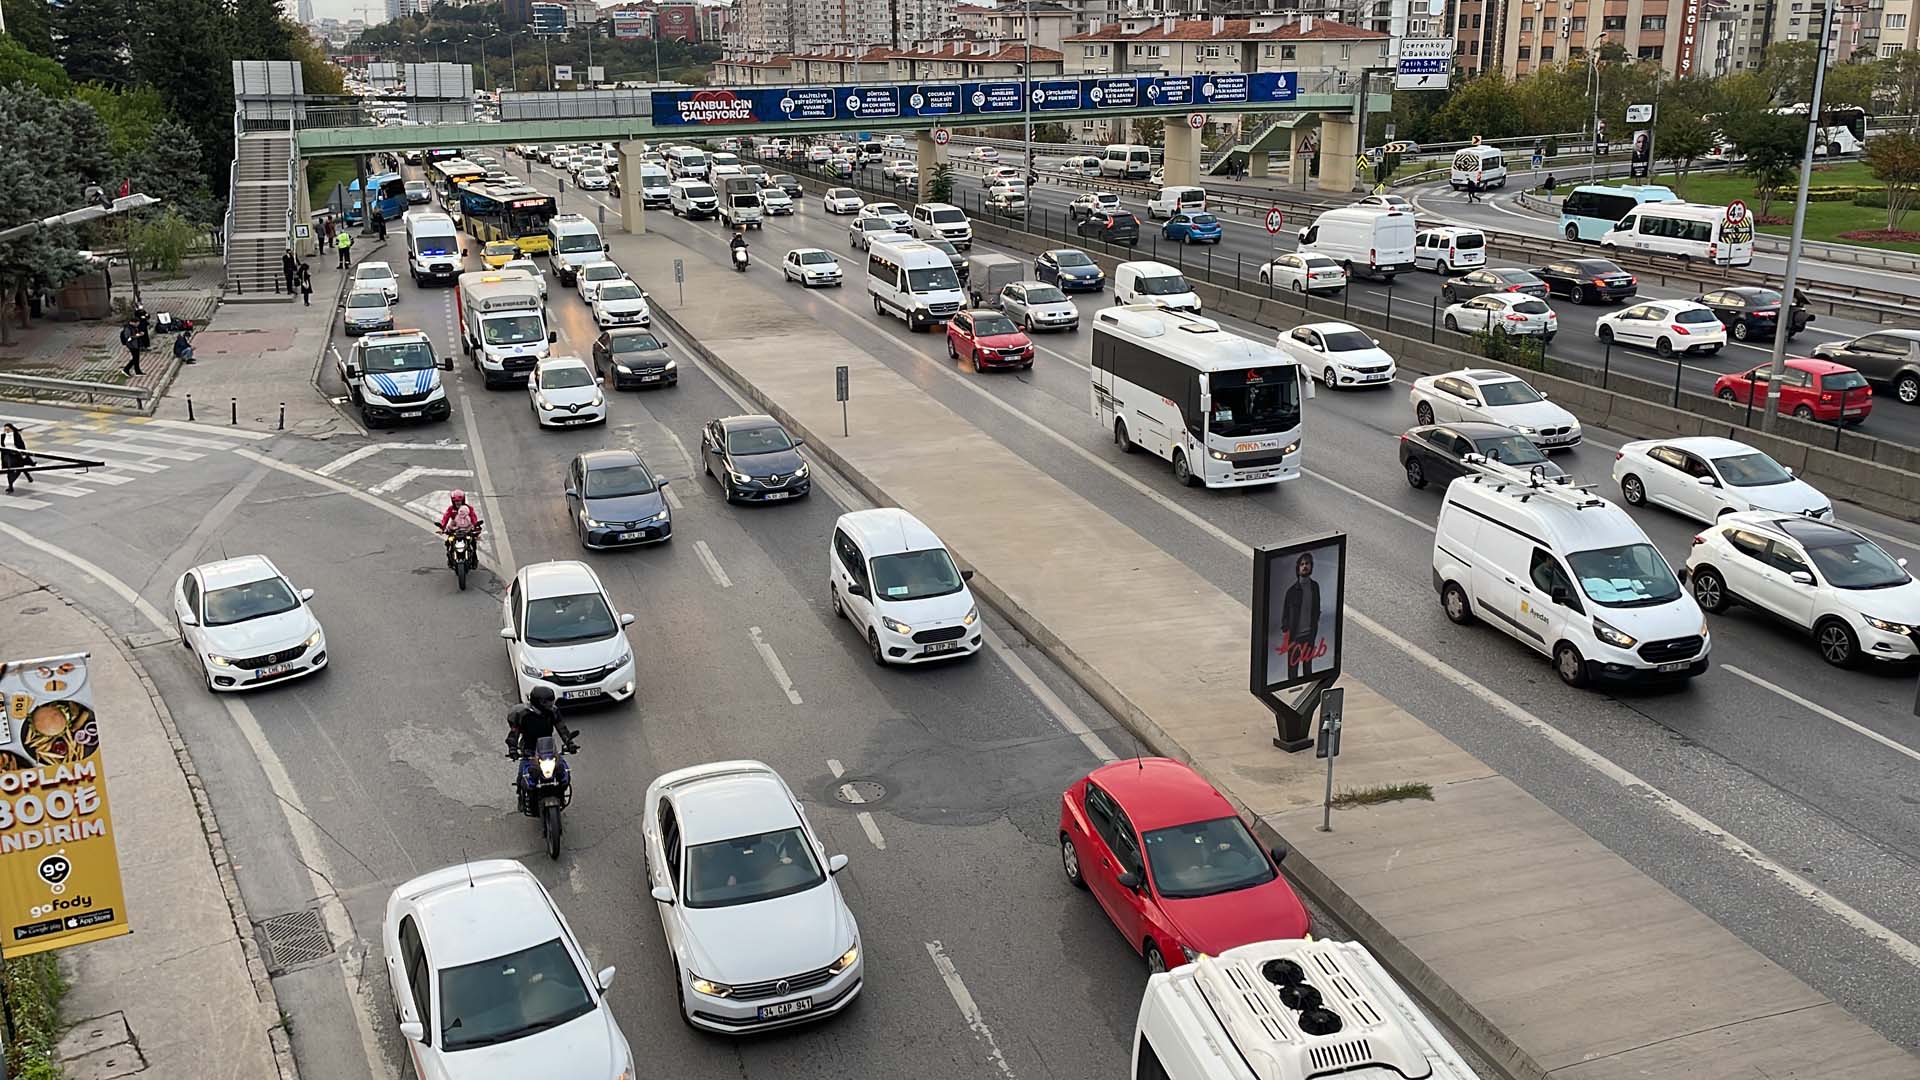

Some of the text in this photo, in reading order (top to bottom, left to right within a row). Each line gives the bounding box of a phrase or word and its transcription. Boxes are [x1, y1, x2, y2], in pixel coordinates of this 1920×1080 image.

[678, 99, 752, 111] İSTANBUL İÇİN
[682, 110, 750, 122] ÇALIŞIYORUZ
[1730, 206, 1736, 218] 4
[0, 818, 106, 853] NDİRİM
[43, 862, 66, 877] go
[30, 895, 92, 918] gofody
[79, 914, 111, 926] App Store
[764, 1000, 810, 1017] 34 CAP 941
